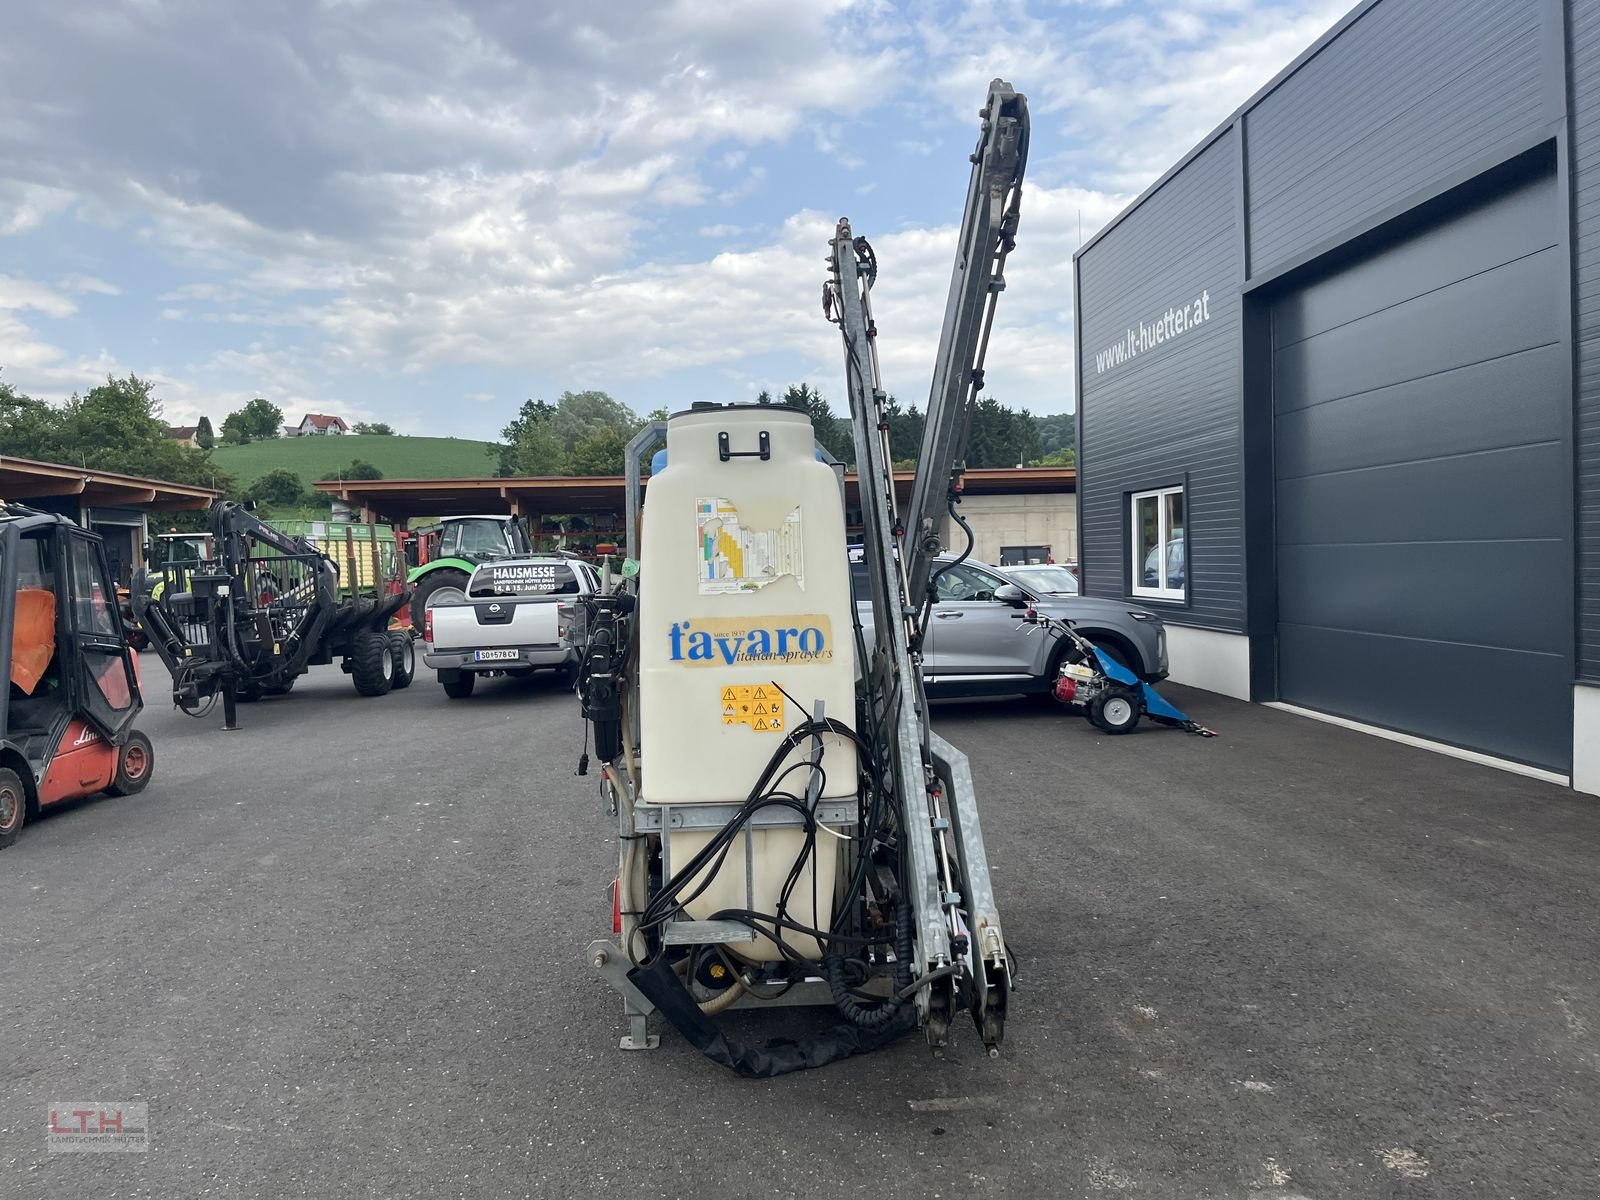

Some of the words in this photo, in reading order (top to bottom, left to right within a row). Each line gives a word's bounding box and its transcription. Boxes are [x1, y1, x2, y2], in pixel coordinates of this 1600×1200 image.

[1095, 289, 1210, 374] www.lt-huetter.at
[493, 566, 555, 579] HAUSMESSE
[731, 630, 745, 638] 1937
[736, 649, 778, 662] italian
[780, 648, 833, 663] sprayers
